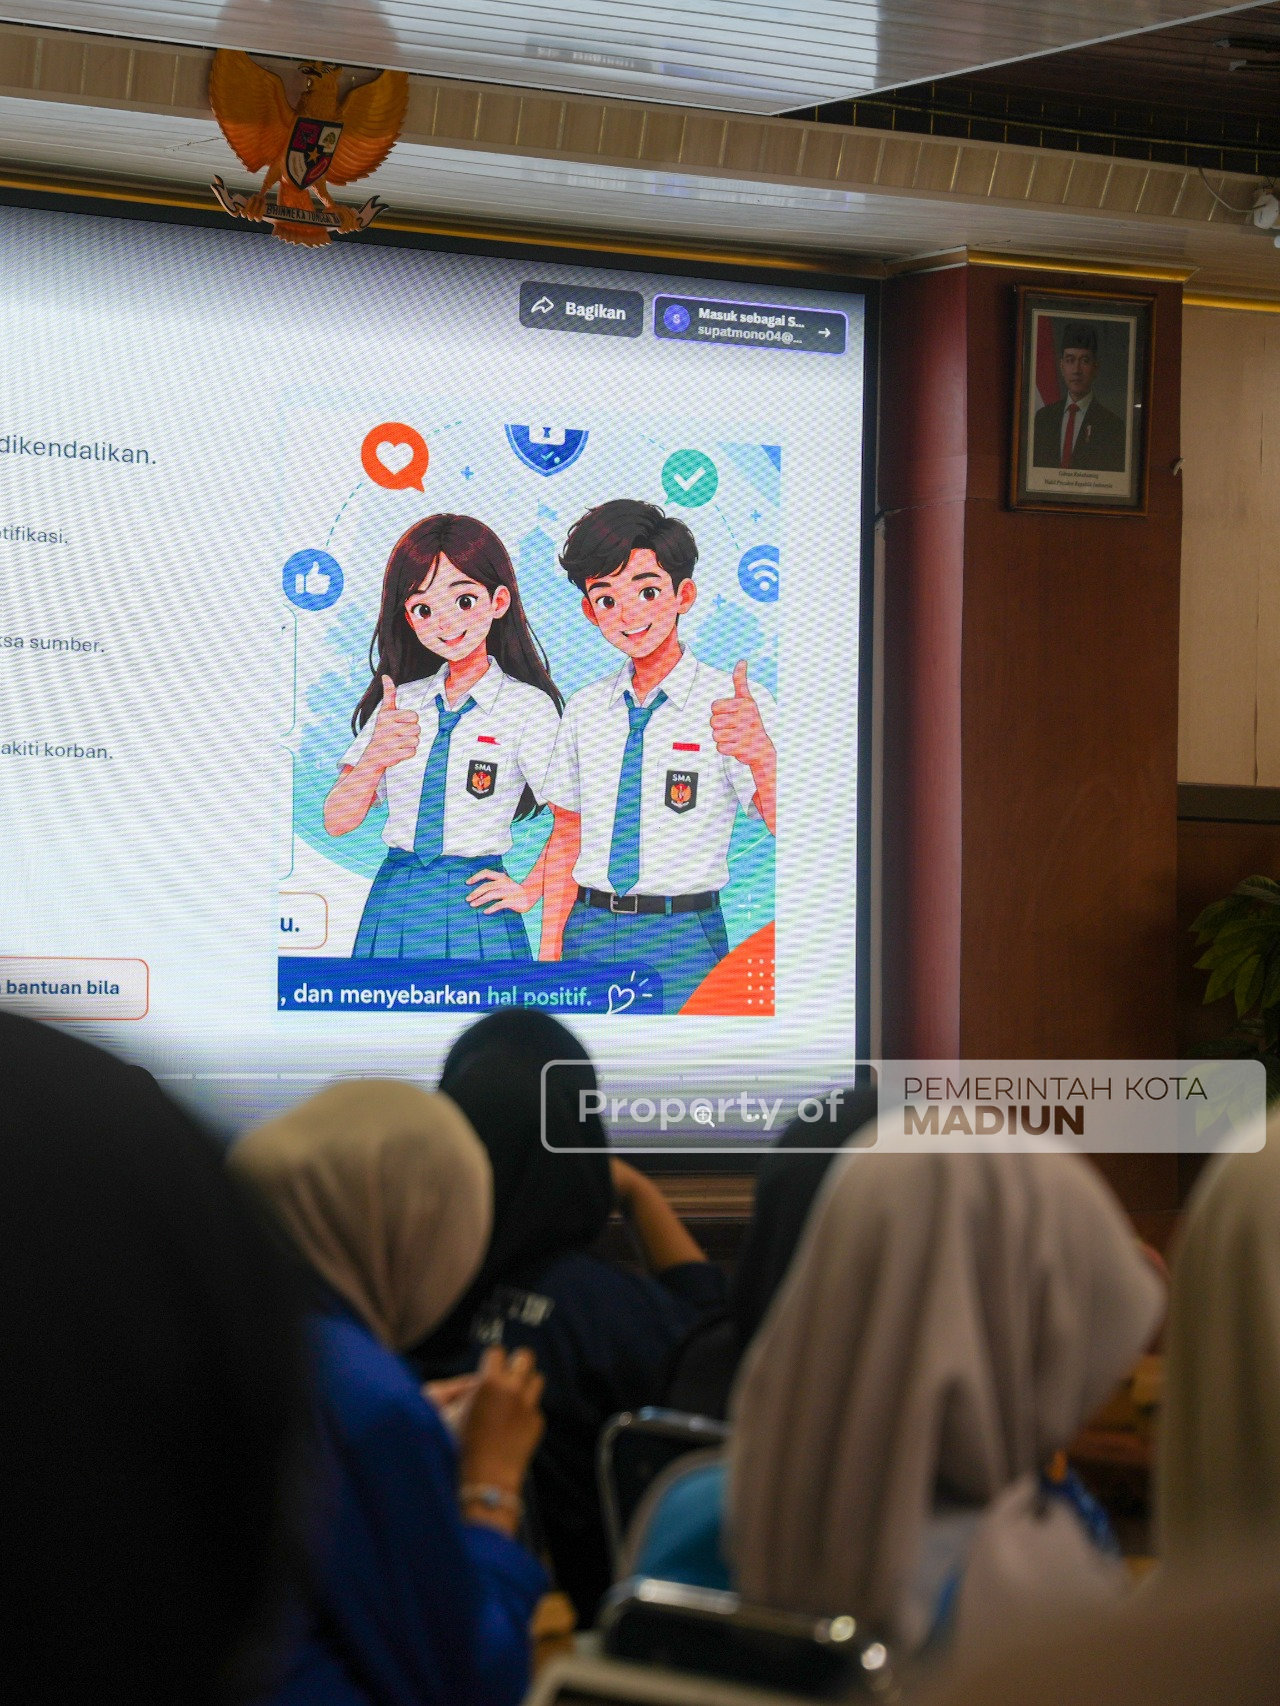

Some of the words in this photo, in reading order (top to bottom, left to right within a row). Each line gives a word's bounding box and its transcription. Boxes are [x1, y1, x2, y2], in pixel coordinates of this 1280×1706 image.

[565, 301, 627, 321] Bagikan
[698, 307, 738, 324] Masuk
[740, 312, 786, 328] sebagai
[28, 633, 105, 654] sumber.
[43, 741, 113, 760] korban.
[474, 763, 492, 773] SMA
[672, 773, 692, 783] SMA
[6, 979, 82, 997] bantuan
[86, 980, 121, 997] bila
[293, 982, 334, 1004] dan
[339, 984, 481, 1008] menyebarkan
[486, 986, 518, 1006] hal
[523, 986, 592, 1009] positif.
